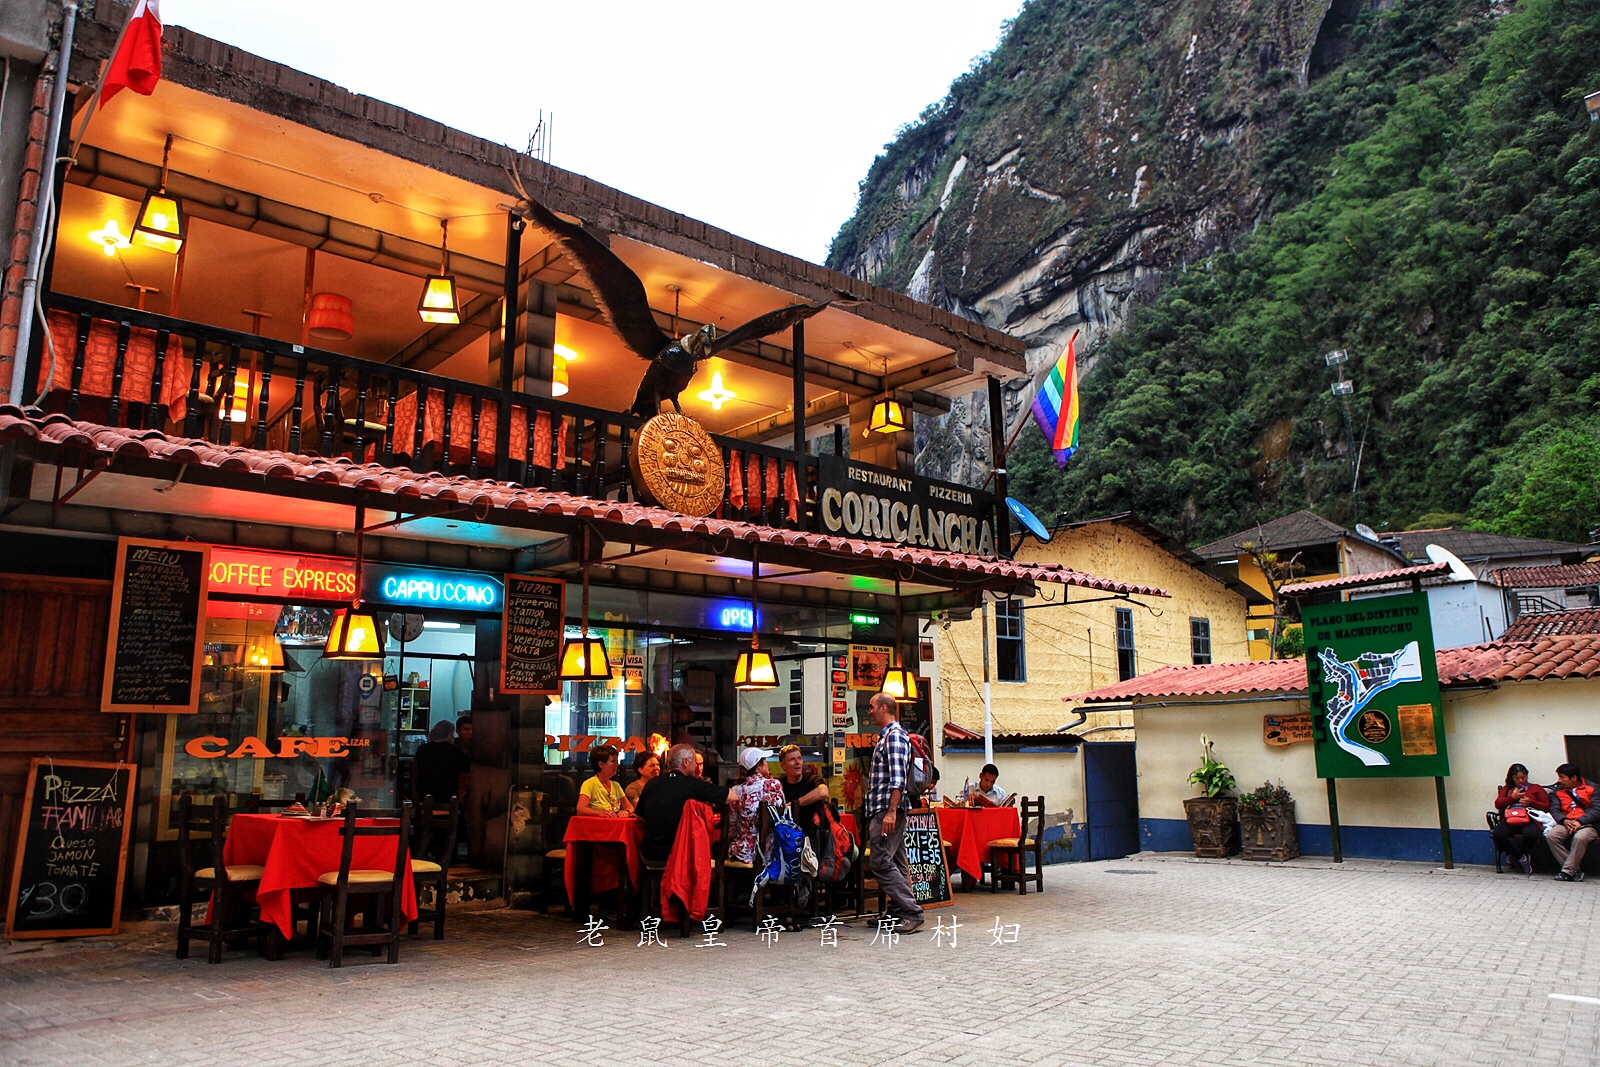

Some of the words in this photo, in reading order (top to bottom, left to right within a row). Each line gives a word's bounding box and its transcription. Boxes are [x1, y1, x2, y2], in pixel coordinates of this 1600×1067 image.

[848, 466, 913, 492] RESTAURANT
[929, 485, 973, 506] PIZZERIA
[821, 487, 995, 556] CORICANCHA
[283, 567, 356, 593] EXPRESS
[516, 581, 553, 595] PIZZAS
[385, 577, 494, 604] CAPPUCCINO
[1310, 614, 1343, 627] PLANO
[1345, 612, 1366, 623] DEL
[1367, 606, 1419, 621] DISTRITO
[1317, 631, 1331, 641] DE
[1335, 622, 1413, 639] MACHUPICCHU
[510, 661, 556, 672] PARRILLAS
[627, 656, 643, 665] VISA
[627, 669, 643, 678] VISA
[184, 736, 350, 758] CAFE
[47, 849, 96, 862] JAMON
